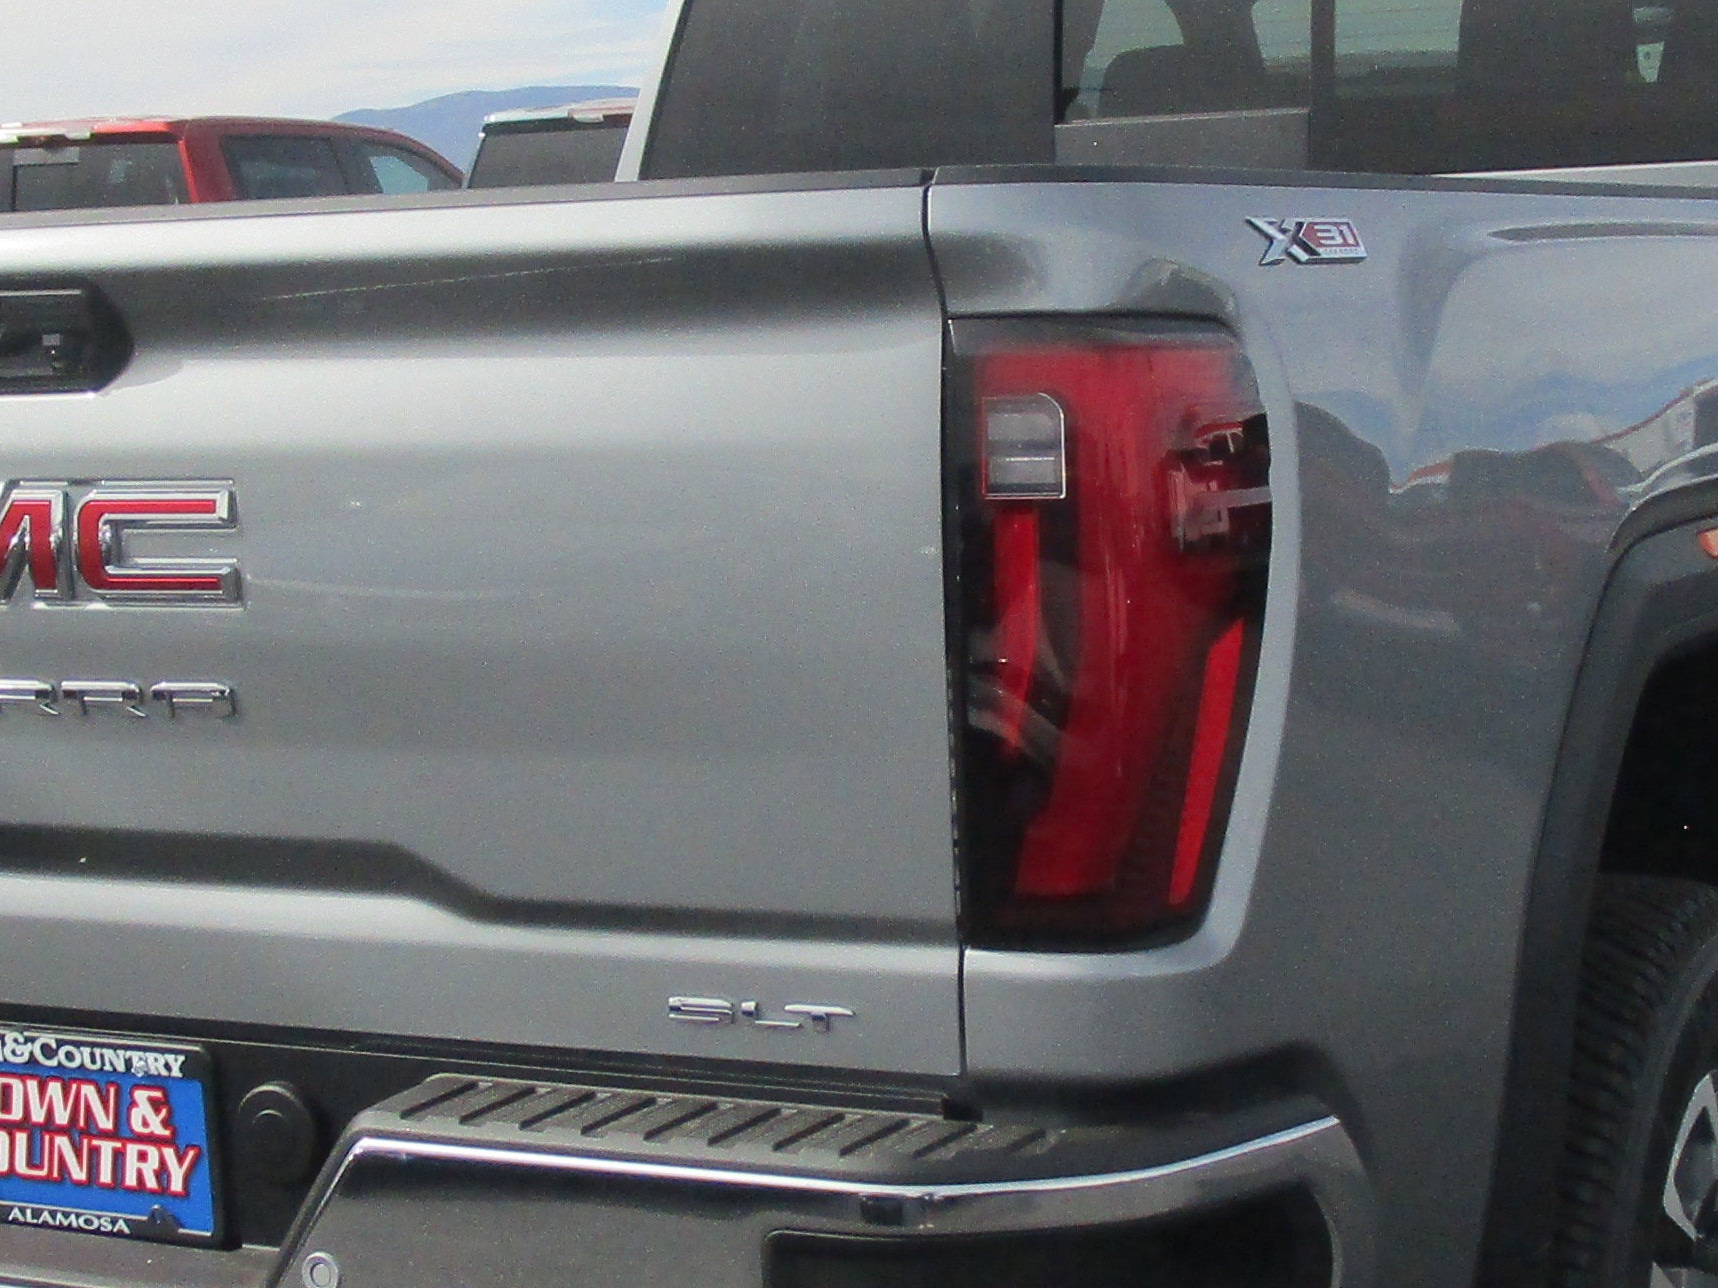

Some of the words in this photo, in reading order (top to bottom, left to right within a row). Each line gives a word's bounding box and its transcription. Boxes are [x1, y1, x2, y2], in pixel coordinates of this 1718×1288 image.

[668, 996, 856, 1032] SLT
[128, 1085, 172, 1139] &
[7, 1206, 131, 1235] ALAMOSA
